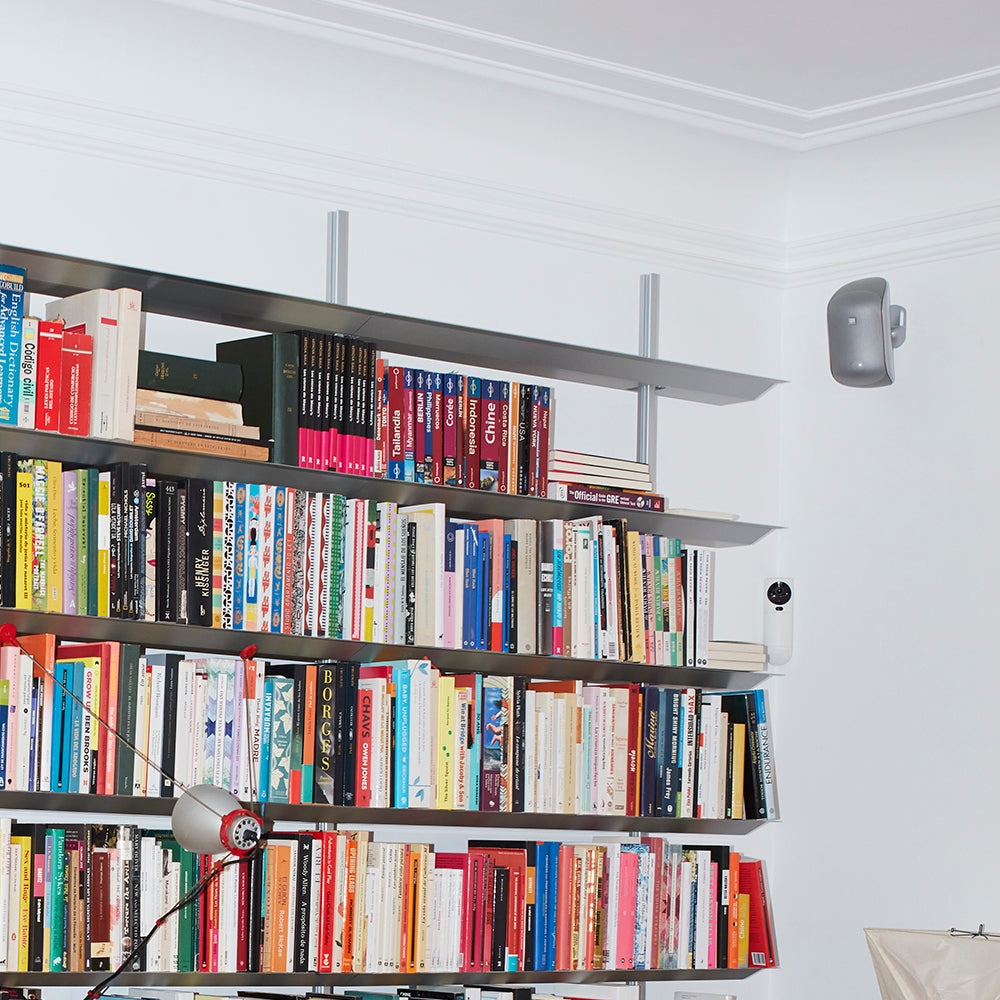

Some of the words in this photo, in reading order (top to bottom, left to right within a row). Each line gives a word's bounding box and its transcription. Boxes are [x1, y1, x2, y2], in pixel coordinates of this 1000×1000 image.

[0, 291, 8, 305] for
[9, 293, 22, 337] English
[4, 341, 18, 408] Dictionary
[22, 343, 35, 377] Código
[22, 379, 35, 397] civil
[445, 398, 454, 427] Corée
[468, 399, 478, 455] Indonesia
[485, 402, 496, 444] Chine
[392, 410, 401, 457] Tailandia
[145, 492, 155, 516] Sissy
[574, 490, 598, 502] Official
[606, 494, 619, 503] GRE
[195, 557, 203, 588] HENRY
[201, 549, 210, 597] KISSINGER
[263, 692, 272, 733] MURAKAMI
[321, 669, 333, 771] BORGES
[361, 695, 371, 738] CHAVS
[645, 710, 657, 759] Marina
[670, 735, 678, 764] MORNING
[361, 742, 369, 766] OWEN
[761, 725, 773, 785] ENDURANCE
[361, 767, 369, 790] JONES
[301, 854, 309, 876] Woody
[55, 871, 64, 896] Sykes
[300, 907, 308, 938] propósito
